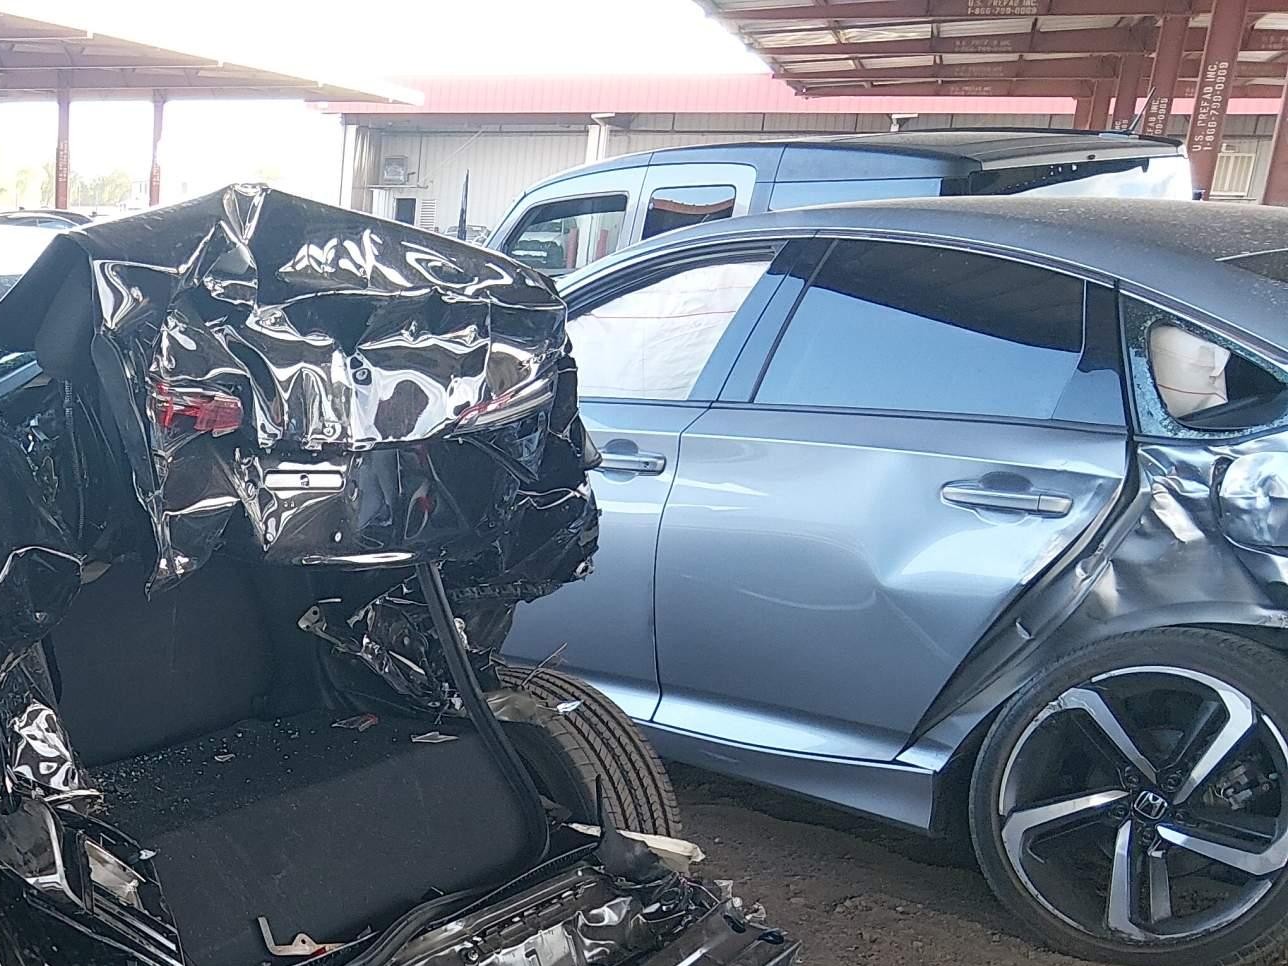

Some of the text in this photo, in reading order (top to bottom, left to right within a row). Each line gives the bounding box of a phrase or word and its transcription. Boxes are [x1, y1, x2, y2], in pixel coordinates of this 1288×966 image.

[1191, 61, 1219, 152] U.S. PREFAB INC.
